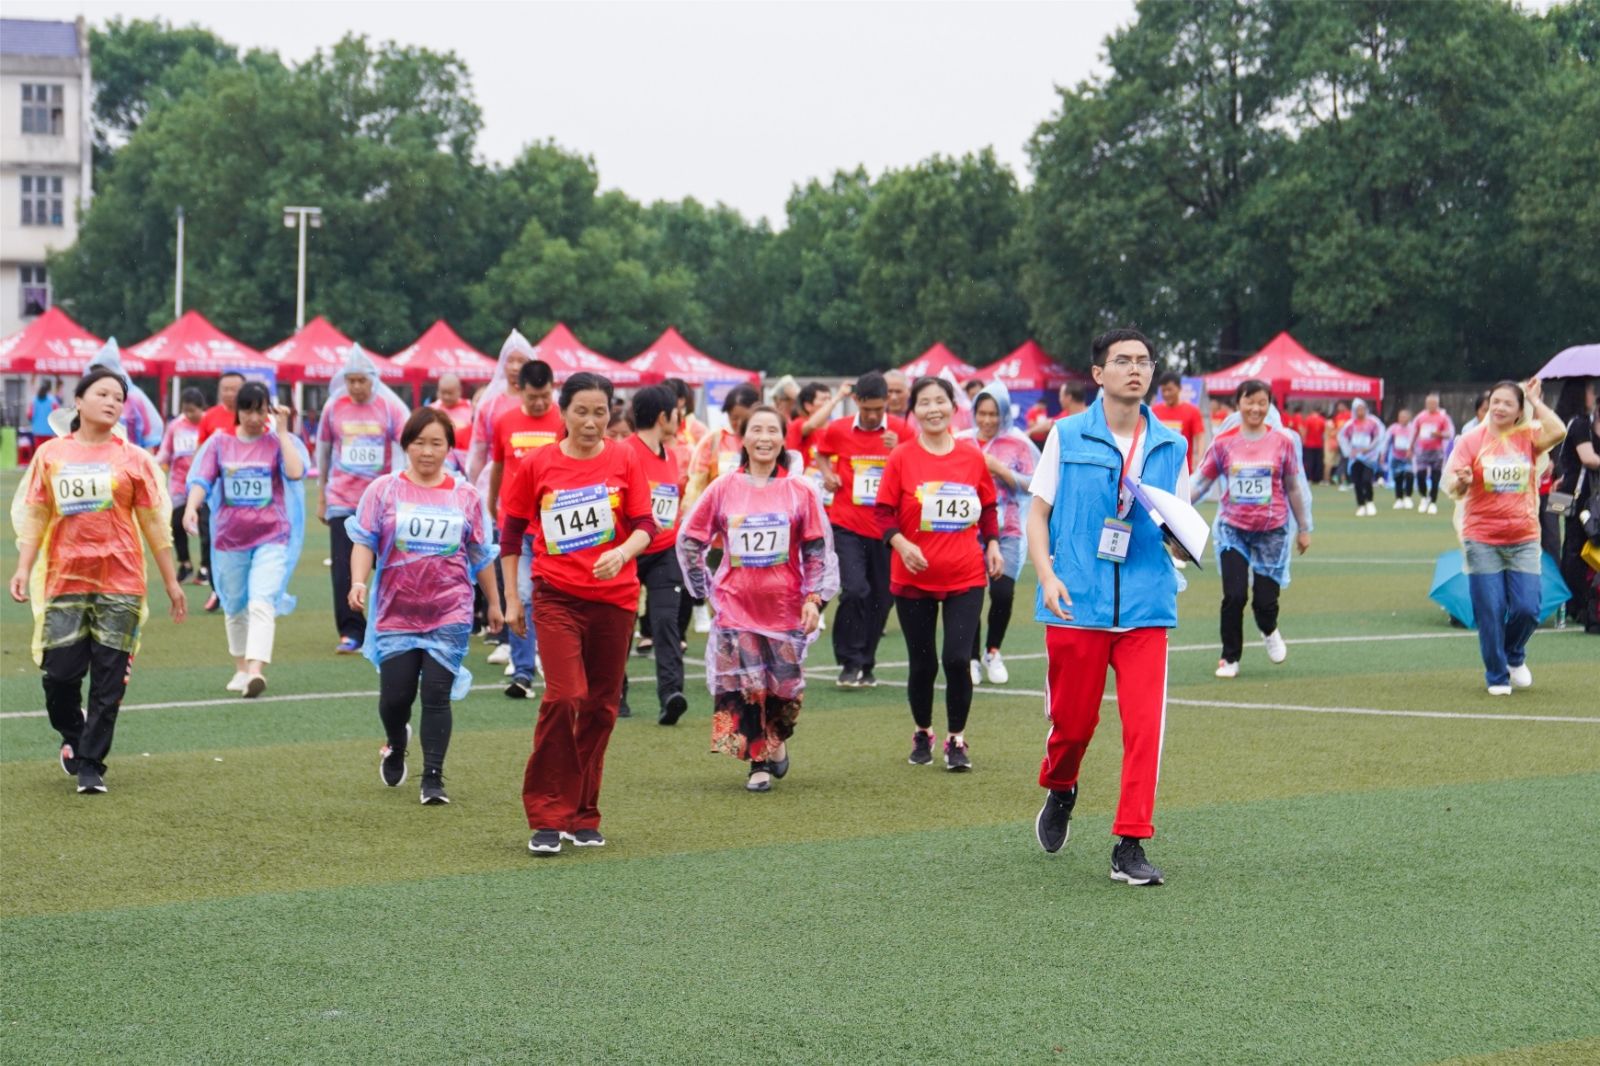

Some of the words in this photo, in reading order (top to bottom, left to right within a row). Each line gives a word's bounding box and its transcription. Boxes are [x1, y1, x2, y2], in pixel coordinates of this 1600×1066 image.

[59, 478, 97, 499] 081
[232, 480, 262, 496] 079
[1237, 479, 1263, 494] 125
[936, 499, 970, 518] 143
[409, 517, 449, 539] 077
[554, 507, 599, 536] 144
[741, 531, 777, 552] 127
